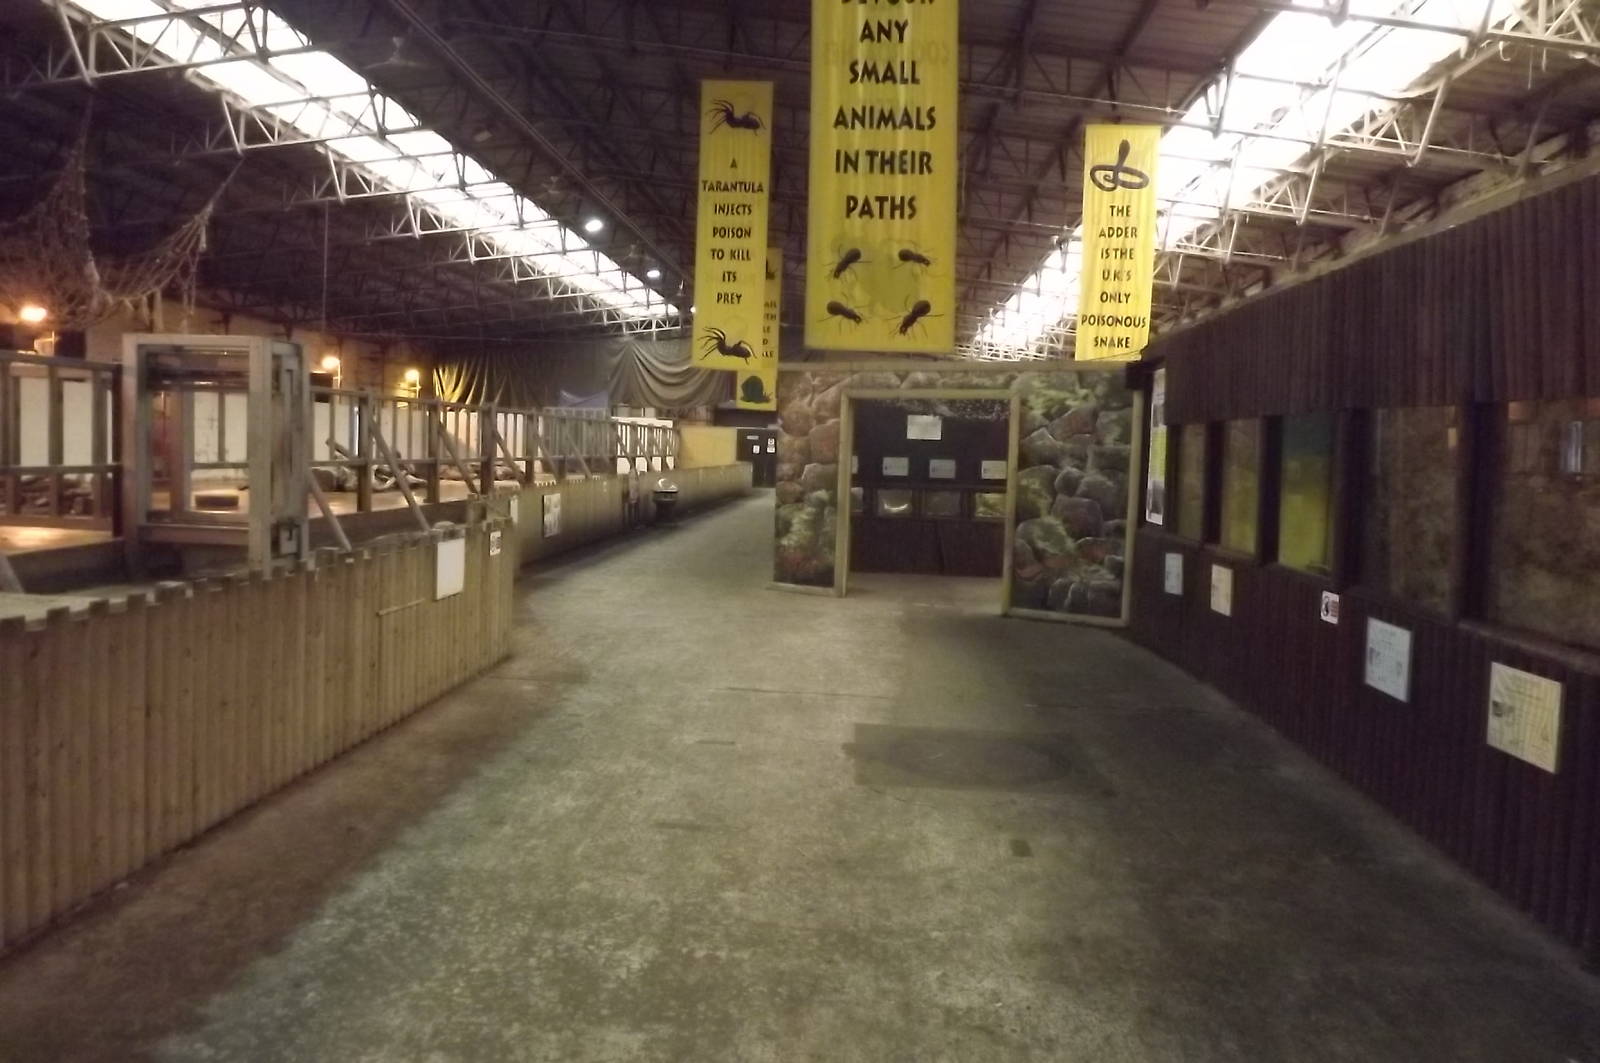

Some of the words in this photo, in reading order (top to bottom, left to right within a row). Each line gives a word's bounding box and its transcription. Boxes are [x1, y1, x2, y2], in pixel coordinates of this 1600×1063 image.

[860, 19, 909, 43] ANY
[849, 60, 920, 85] SMALL
[833, 105, 937, 131] ANIMALS
[730, 157, 738, 169] A
[835, 149, 859, 174] IN
[865, 149, 933, 175] THEIR
[702, 180, 764, 193] TARANTULA
[714, 203, 752, 216] INJECTS
[845, 195, 917, 220] PATHS
[1109, 204, 1131, 217] THE
[712, 226, 751, 239] POISON
[1098, 226, 1137, 238] ADDER
[710, 248, 725, 260] TO
[730, 248, 751, 261] KILL
[1100, 247, 1110, 260] IS
[1113, 247, 1134, 260] THE
[722, 270, 737, 283] ITS
[716, 292, 742, 305] PREY
[1099, 291, 1131, 304] ONLY
[1081, 314, 1146, 329] POISONOUS
[1094, 335, 1131, 349] SNAKE
